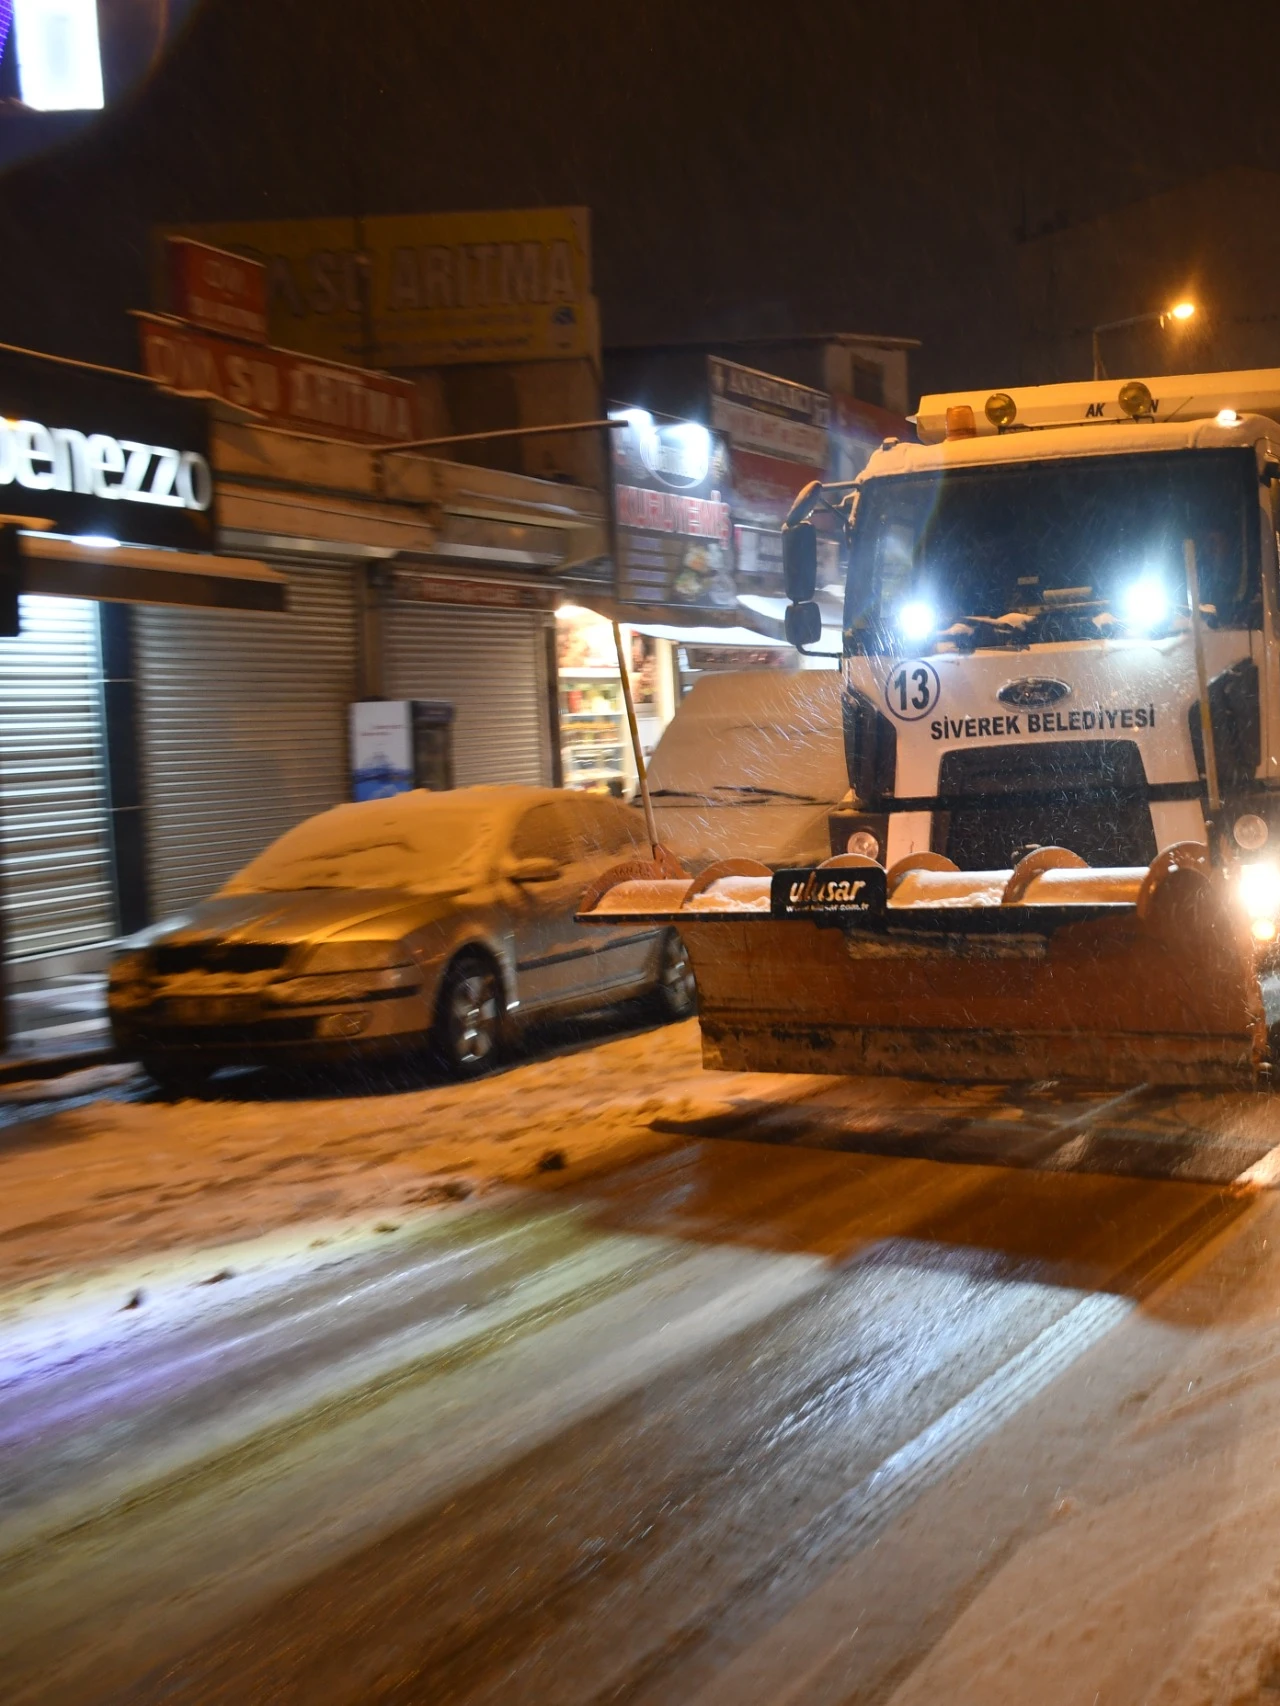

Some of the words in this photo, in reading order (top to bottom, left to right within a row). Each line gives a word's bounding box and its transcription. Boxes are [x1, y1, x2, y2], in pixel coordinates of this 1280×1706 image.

[894, 668, 930, 711] 13
[931, 716, 1020, 740] SİVEREK
[1028, 703, 1155, 733] BELEDİYESİ
